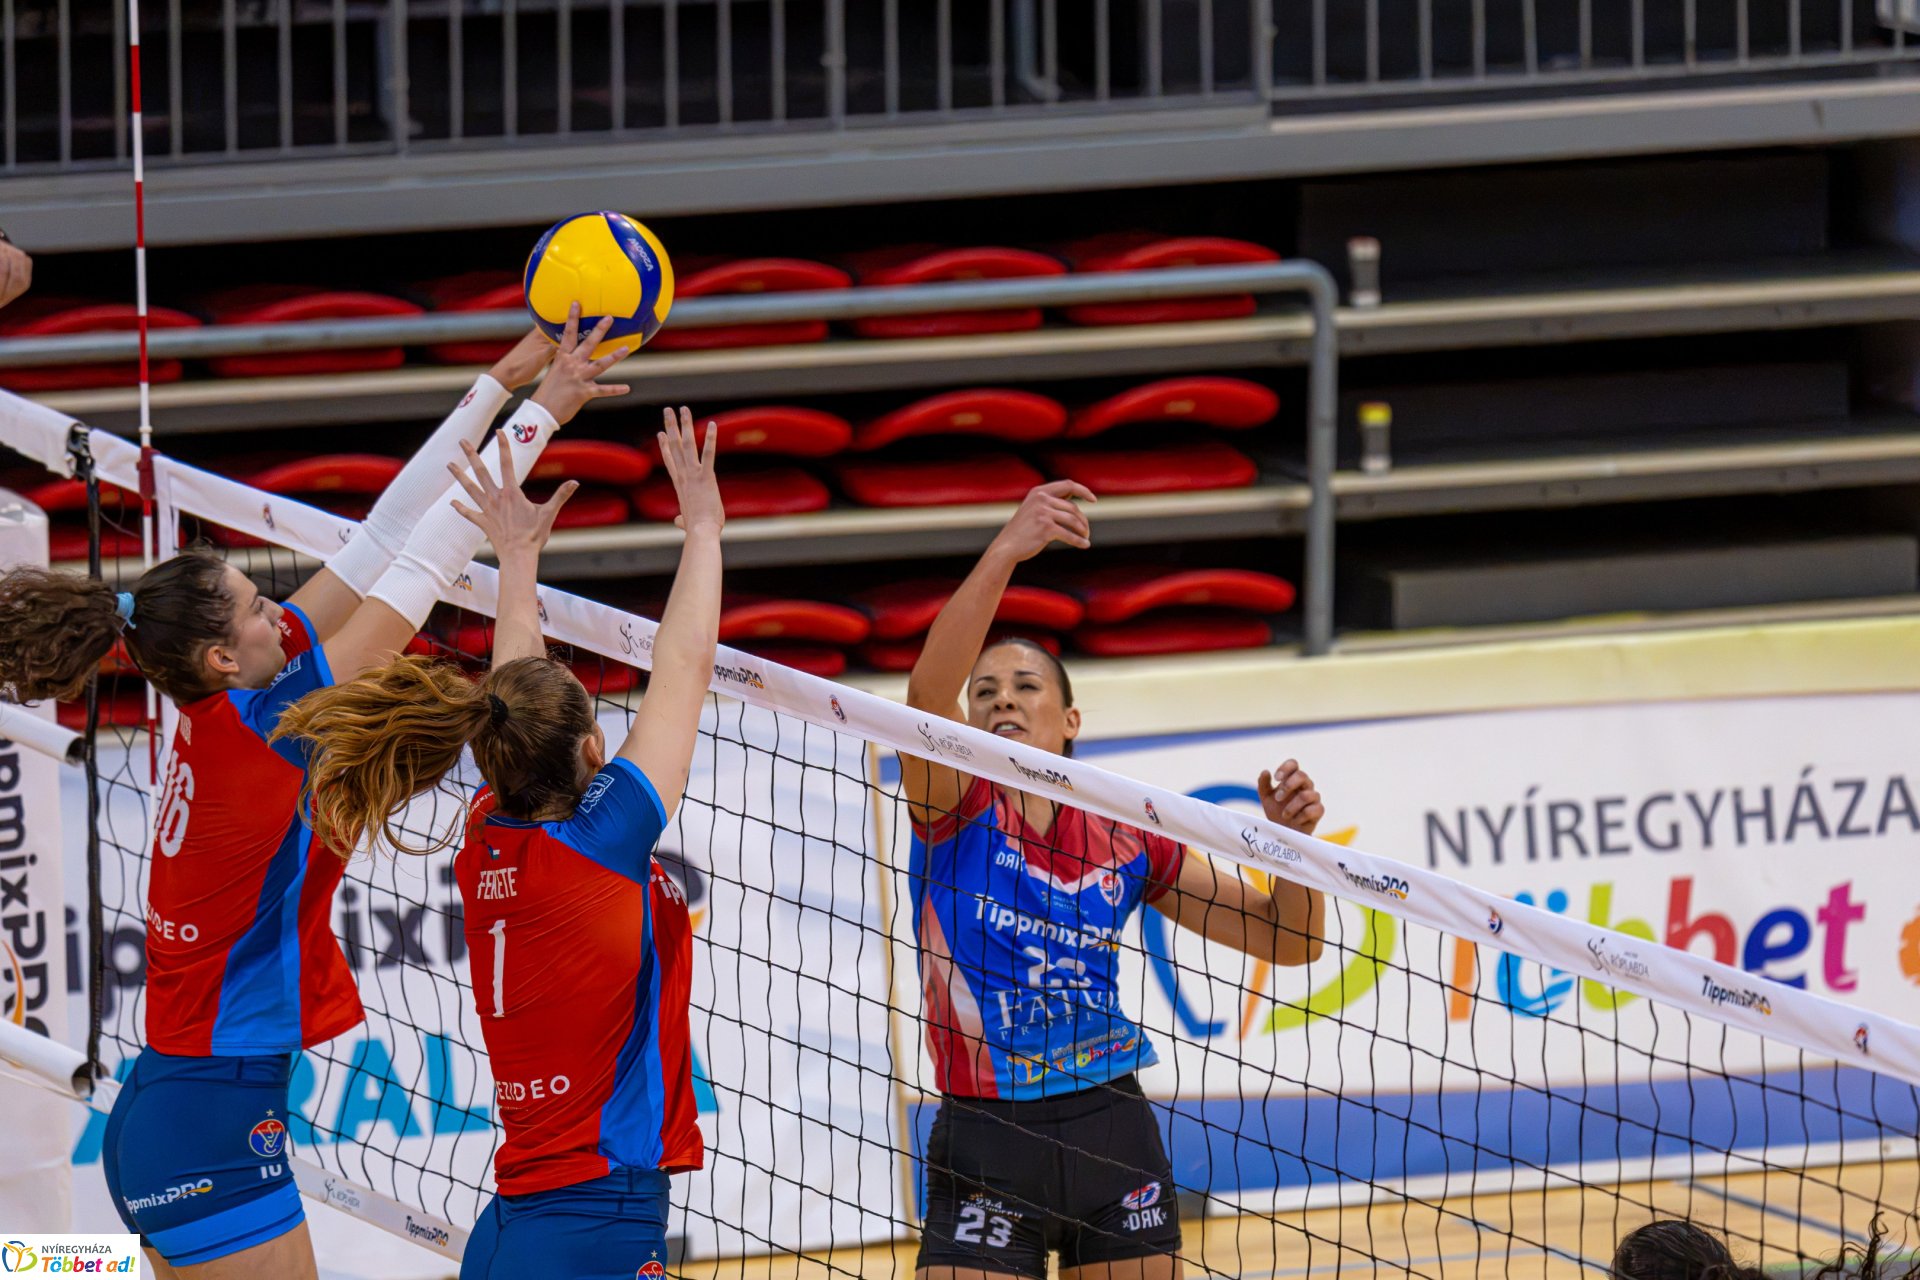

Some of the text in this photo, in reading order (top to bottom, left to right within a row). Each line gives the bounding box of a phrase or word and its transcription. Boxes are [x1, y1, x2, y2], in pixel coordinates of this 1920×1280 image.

[1424, 765, 1920, 869] NYÍREGYHÁZA
[488, 918, 507, 1018] 1
[954, 1205, 1013, 1248] 23
